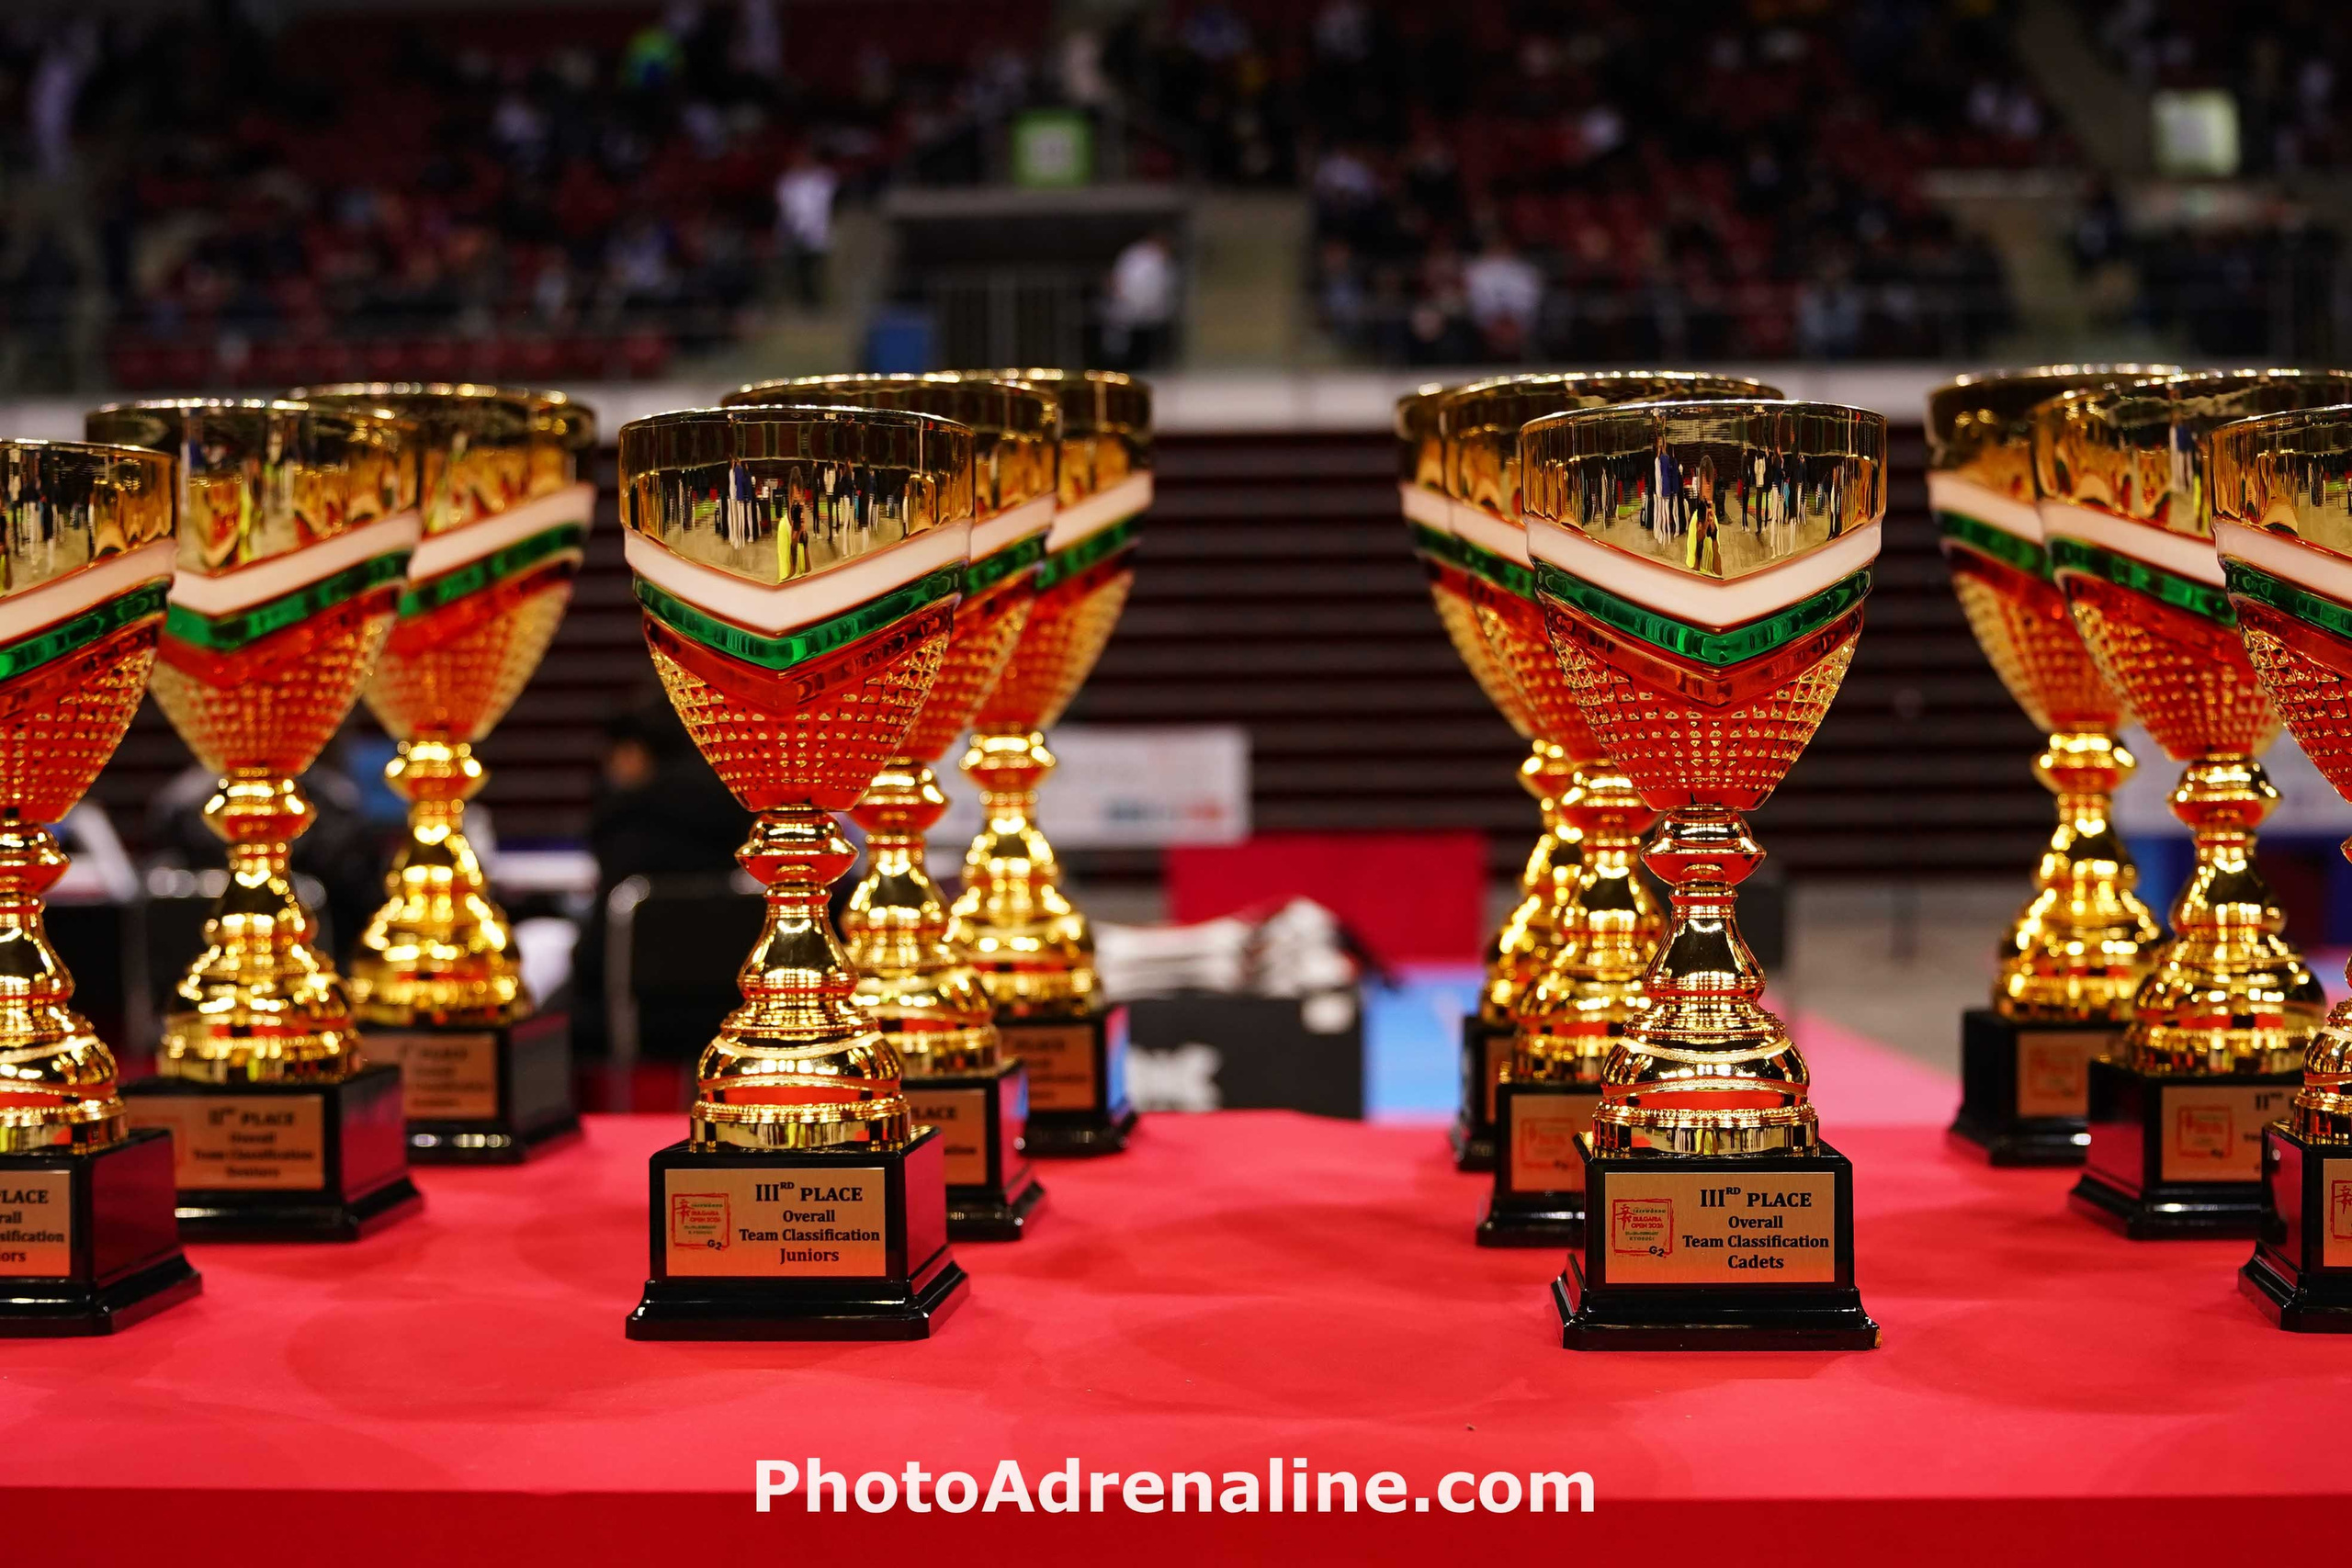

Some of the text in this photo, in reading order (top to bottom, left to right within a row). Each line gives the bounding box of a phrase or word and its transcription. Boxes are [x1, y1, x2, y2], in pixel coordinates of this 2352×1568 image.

[0, 1190, 49, 1203] LACE
[800, 1187, 863, 1201] PLACE
[1747, 1192, 1812, 1207] PLACE
[783, 1210, 835, 1223] Overall
[1728, 1215, 1783, 1228] Overall
[739, 1228, 880, 1241] Team Classification
[1682, 1235, 1829, 1247] Team Classification
[707, 1239, 722, 1250] G2
[780, 1248, 839, 1265] Juniors
[1649, 1246, 1665, 1257] G2
[1727, 1255, 1784, 1269] Cadets
